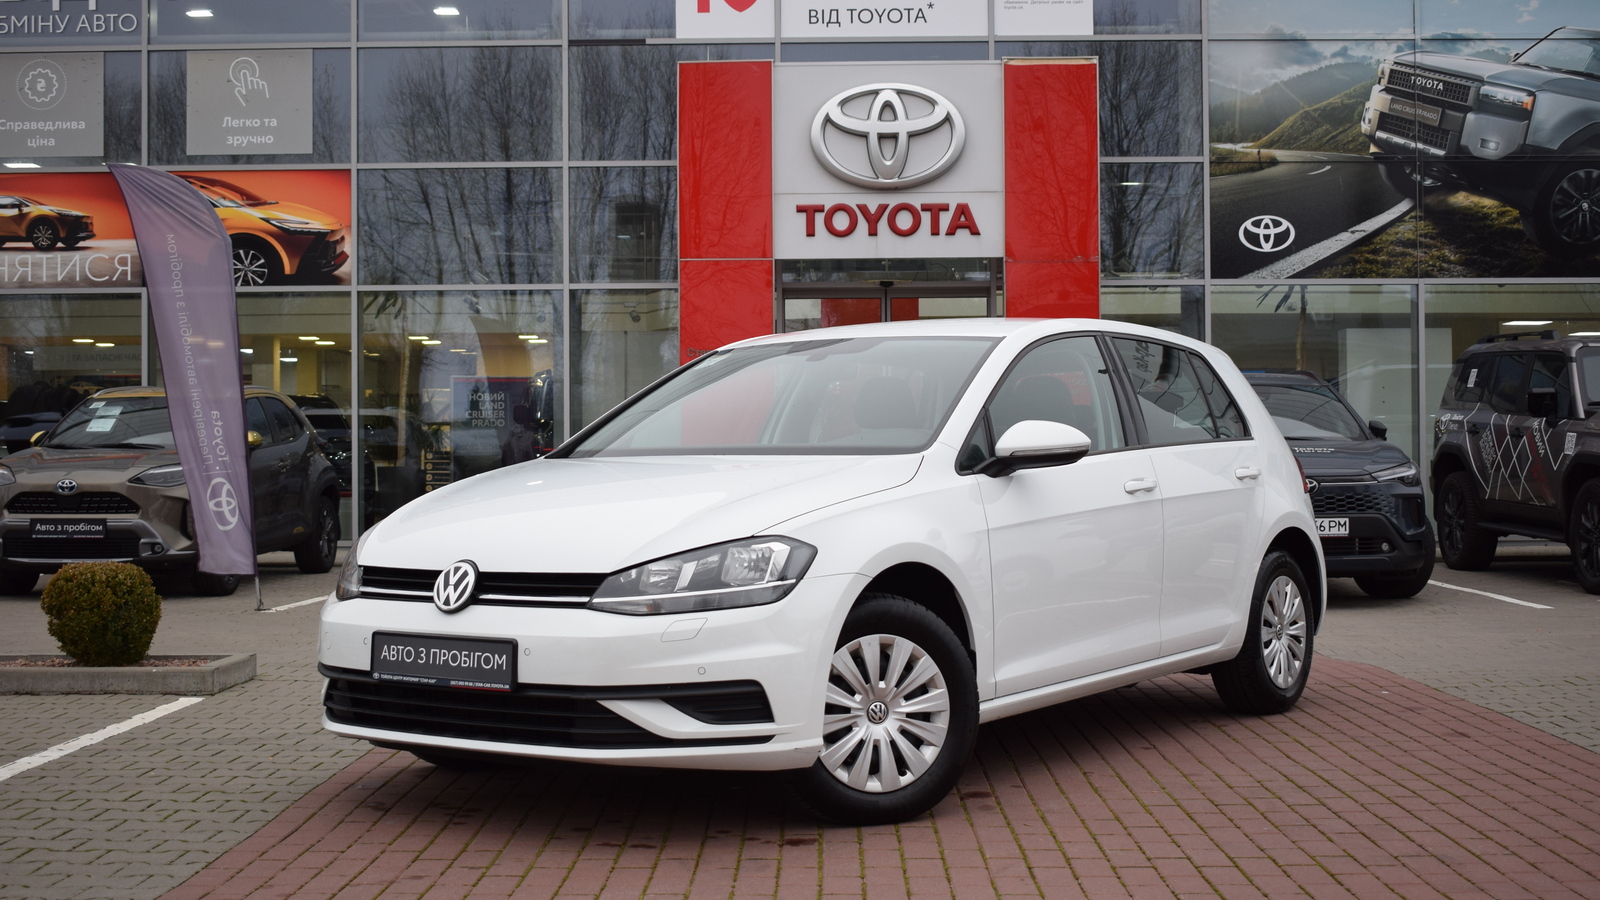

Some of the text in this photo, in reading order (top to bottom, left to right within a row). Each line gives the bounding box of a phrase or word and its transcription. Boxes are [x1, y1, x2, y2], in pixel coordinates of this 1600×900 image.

[76, 13, 138, 33] АВТО
[808, 9, 841, 28] ВІД
[1410, 76, 1443, 90] TOYOTA
[0, 119, 86, 133] Справедлива
[222, 116, 278, 128] Легко та
[27, 135, 55, 149] ціна
[226, 135, 274, 147] зручно
[796, 202, 981, 238] TOYOTA
[469, 391, 505, 401] НОВИЙ
[478, 401, 505, 410] LAND
[465, 410, 505, 419] CRUISER
[471, 419, 505, 427] PRADO
[35, 523, 55, 531] Авто
[63, 522, 103, 533] пробігом
[1315, 520, 1347, 532] 6 PM
[380, 645, 415, 663] АВТО
[429, 648, 507, 670] ПРОБІГОМ
